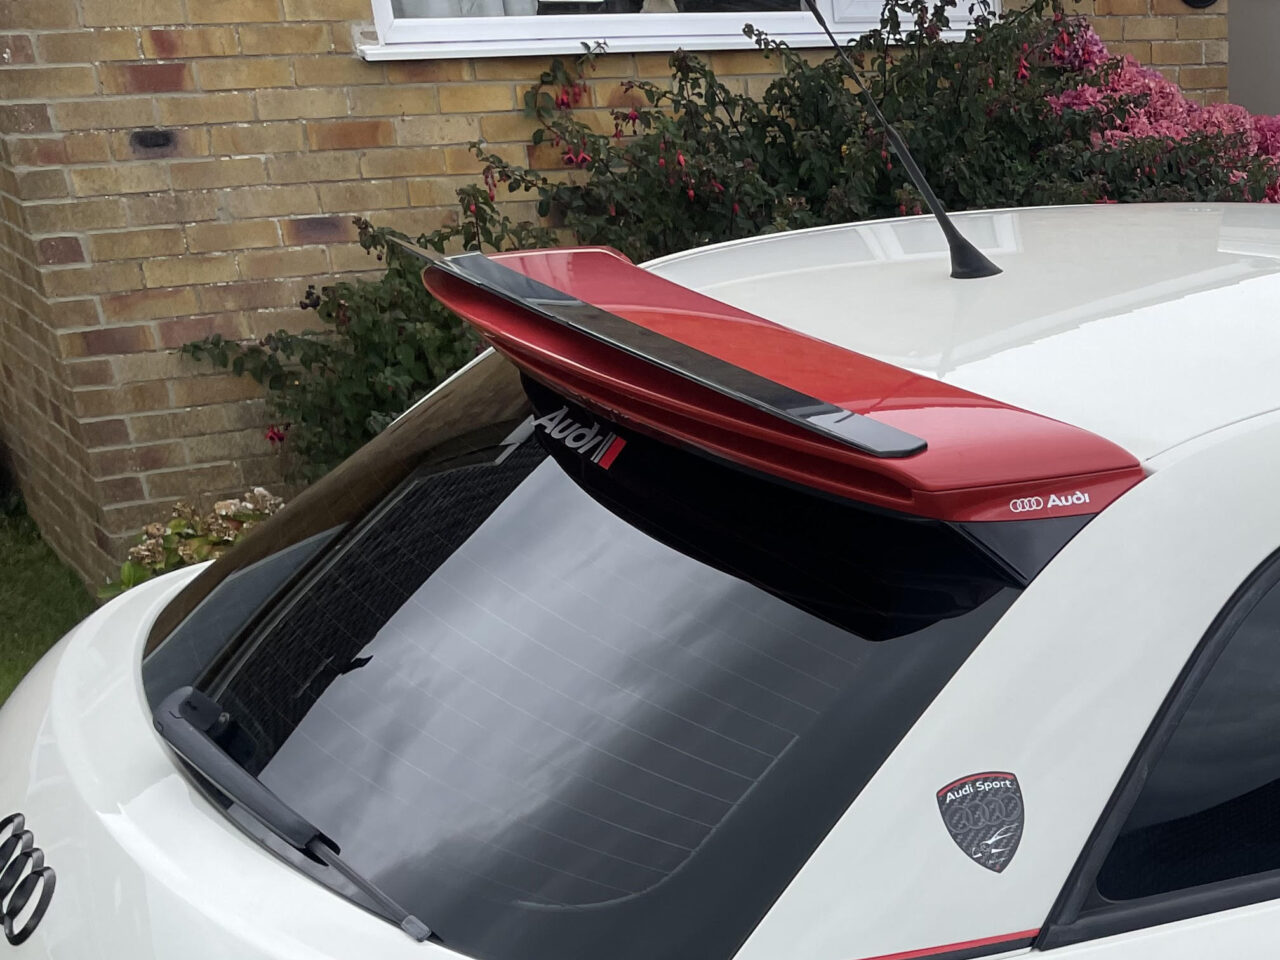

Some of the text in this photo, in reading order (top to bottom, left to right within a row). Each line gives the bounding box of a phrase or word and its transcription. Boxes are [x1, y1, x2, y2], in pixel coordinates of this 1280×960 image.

[530, 404, 604, 454] Audi
[1046, 491, 1091, 508] Audi
[945, 779, 1012, 804] Audi Sport
